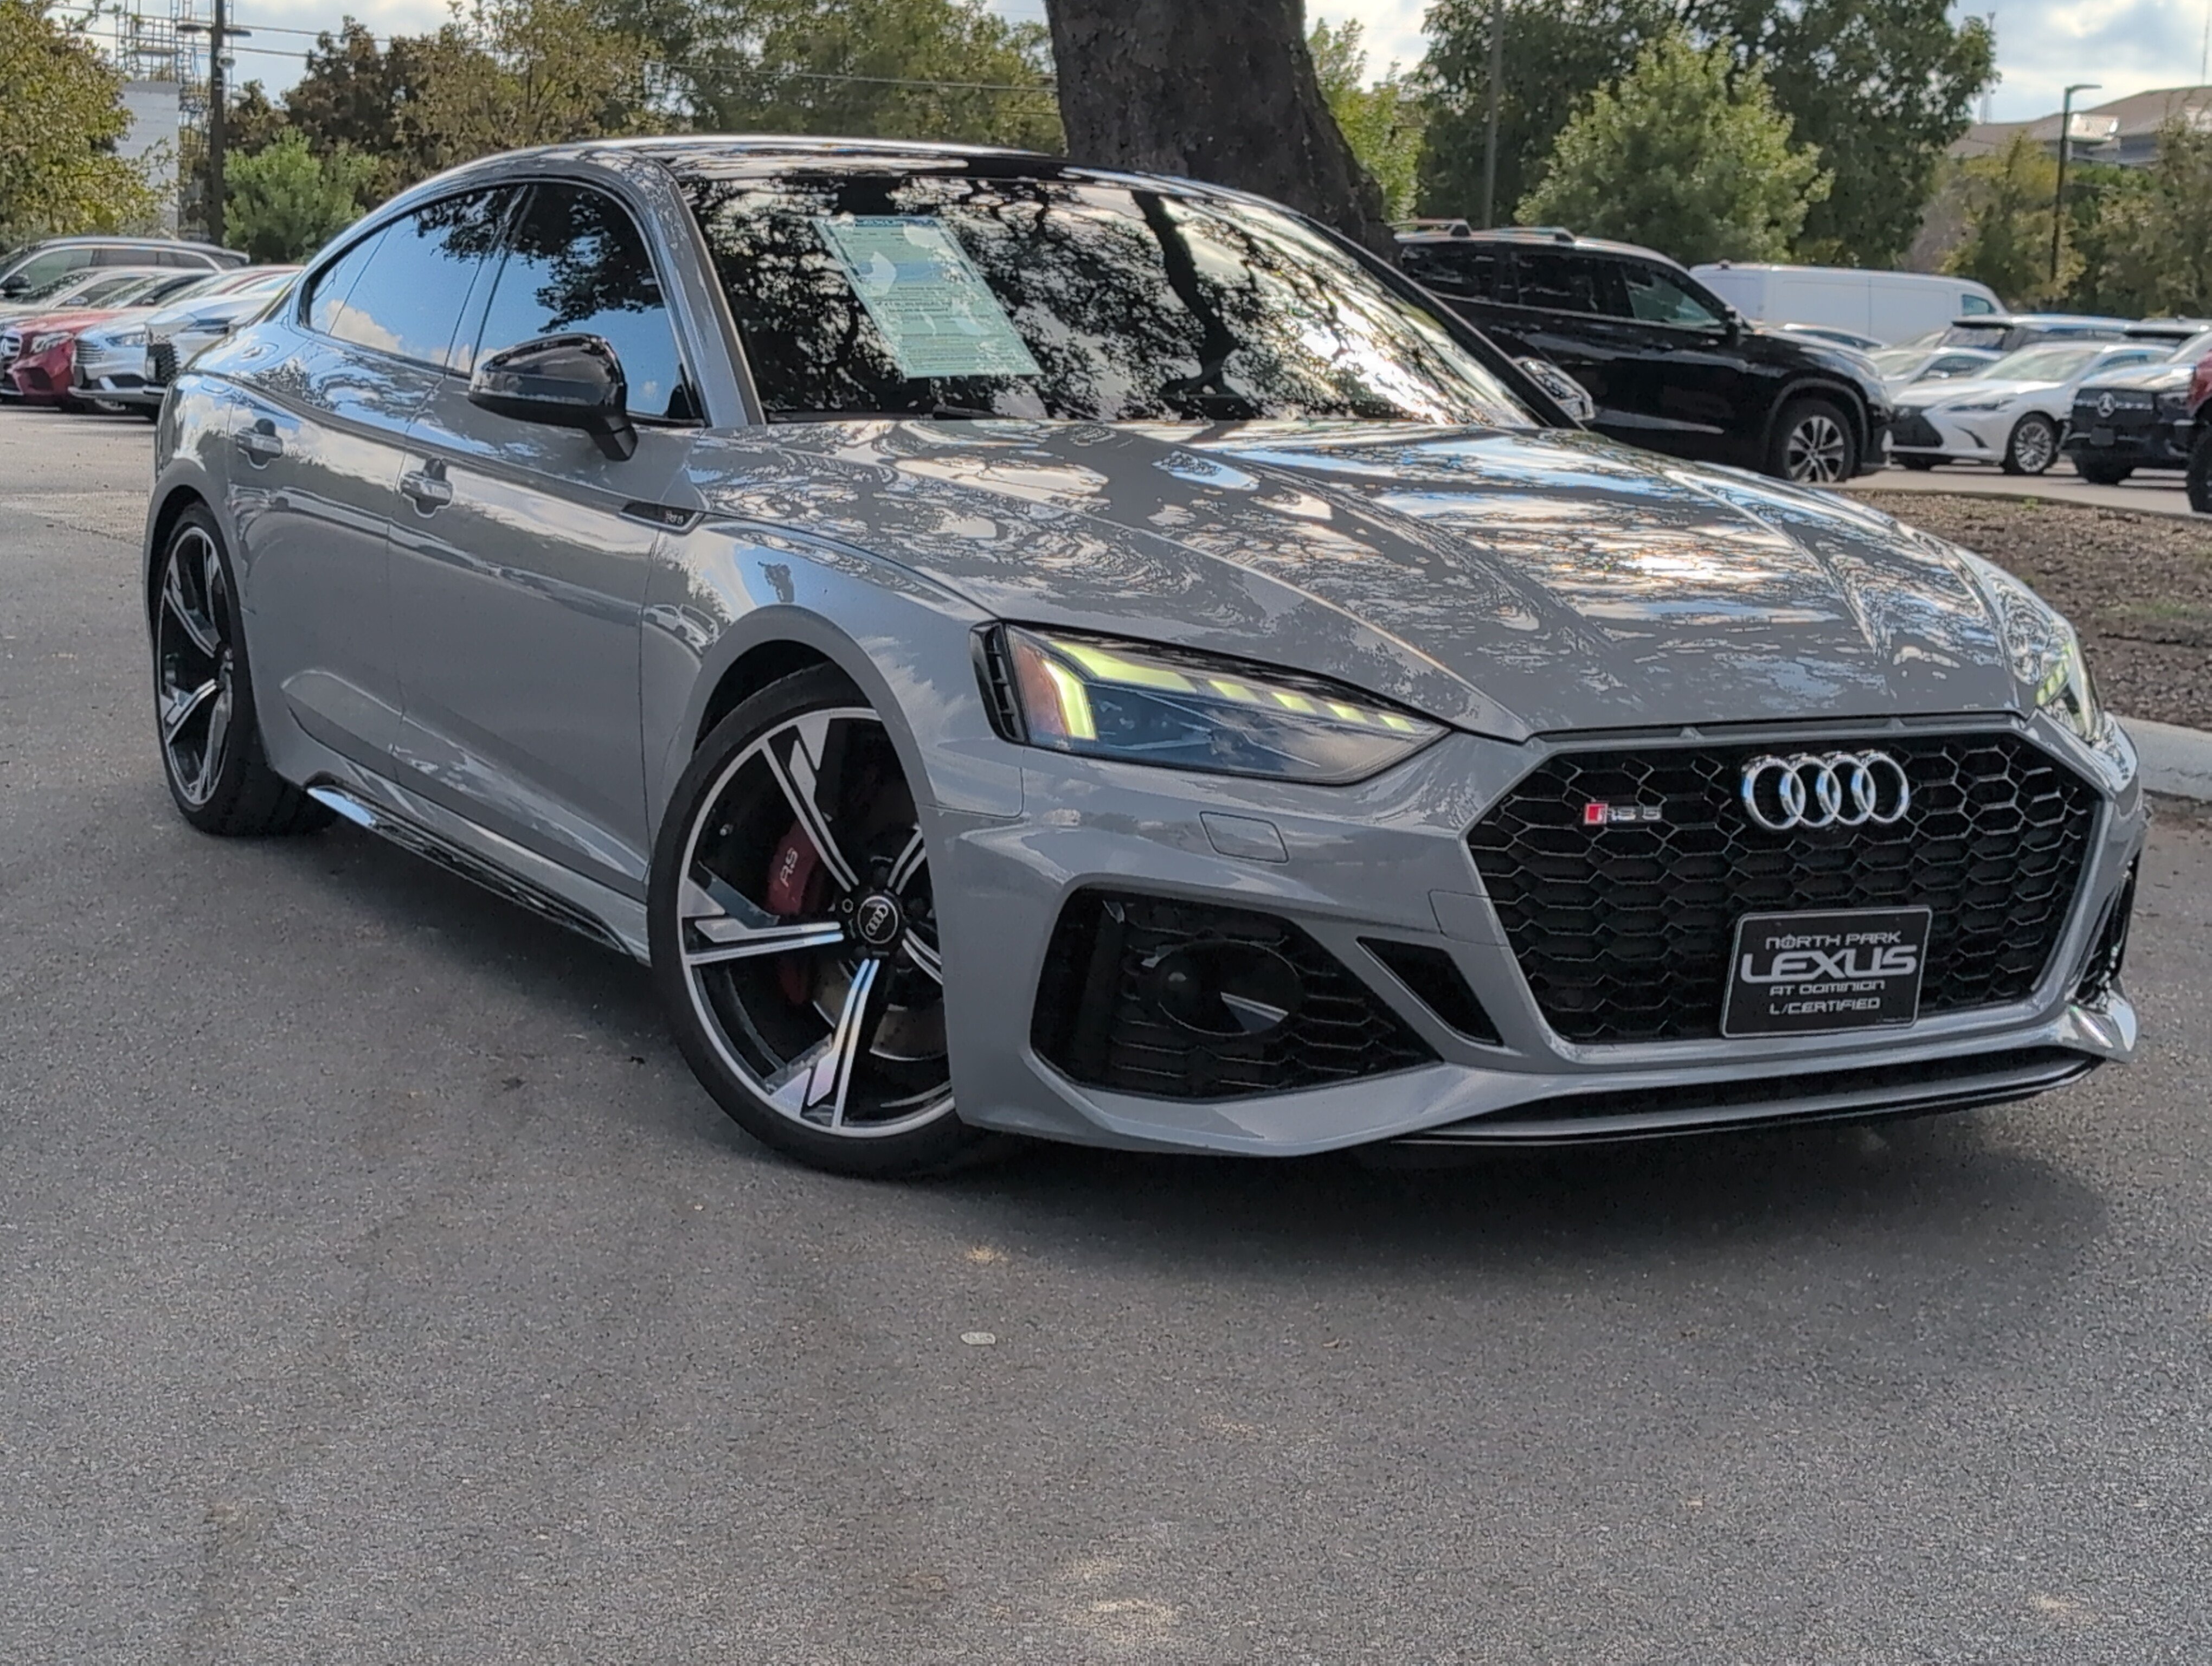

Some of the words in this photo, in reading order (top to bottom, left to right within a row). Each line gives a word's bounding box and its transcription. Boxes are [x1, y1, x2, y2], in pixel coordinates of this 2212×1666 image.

[780, 847, 799, 888] RS
[1765, 933, 1842, 950] NORTH
[1844, 930, 1902, 946] PARK
[1740, 945, 1918, 983] LEXUS
[1769, 984, 1796, 997] AT
[1799, 979, 1886, 995] DOMINION
[1769, 997, 1881, 1015] L/CERTIFIED
